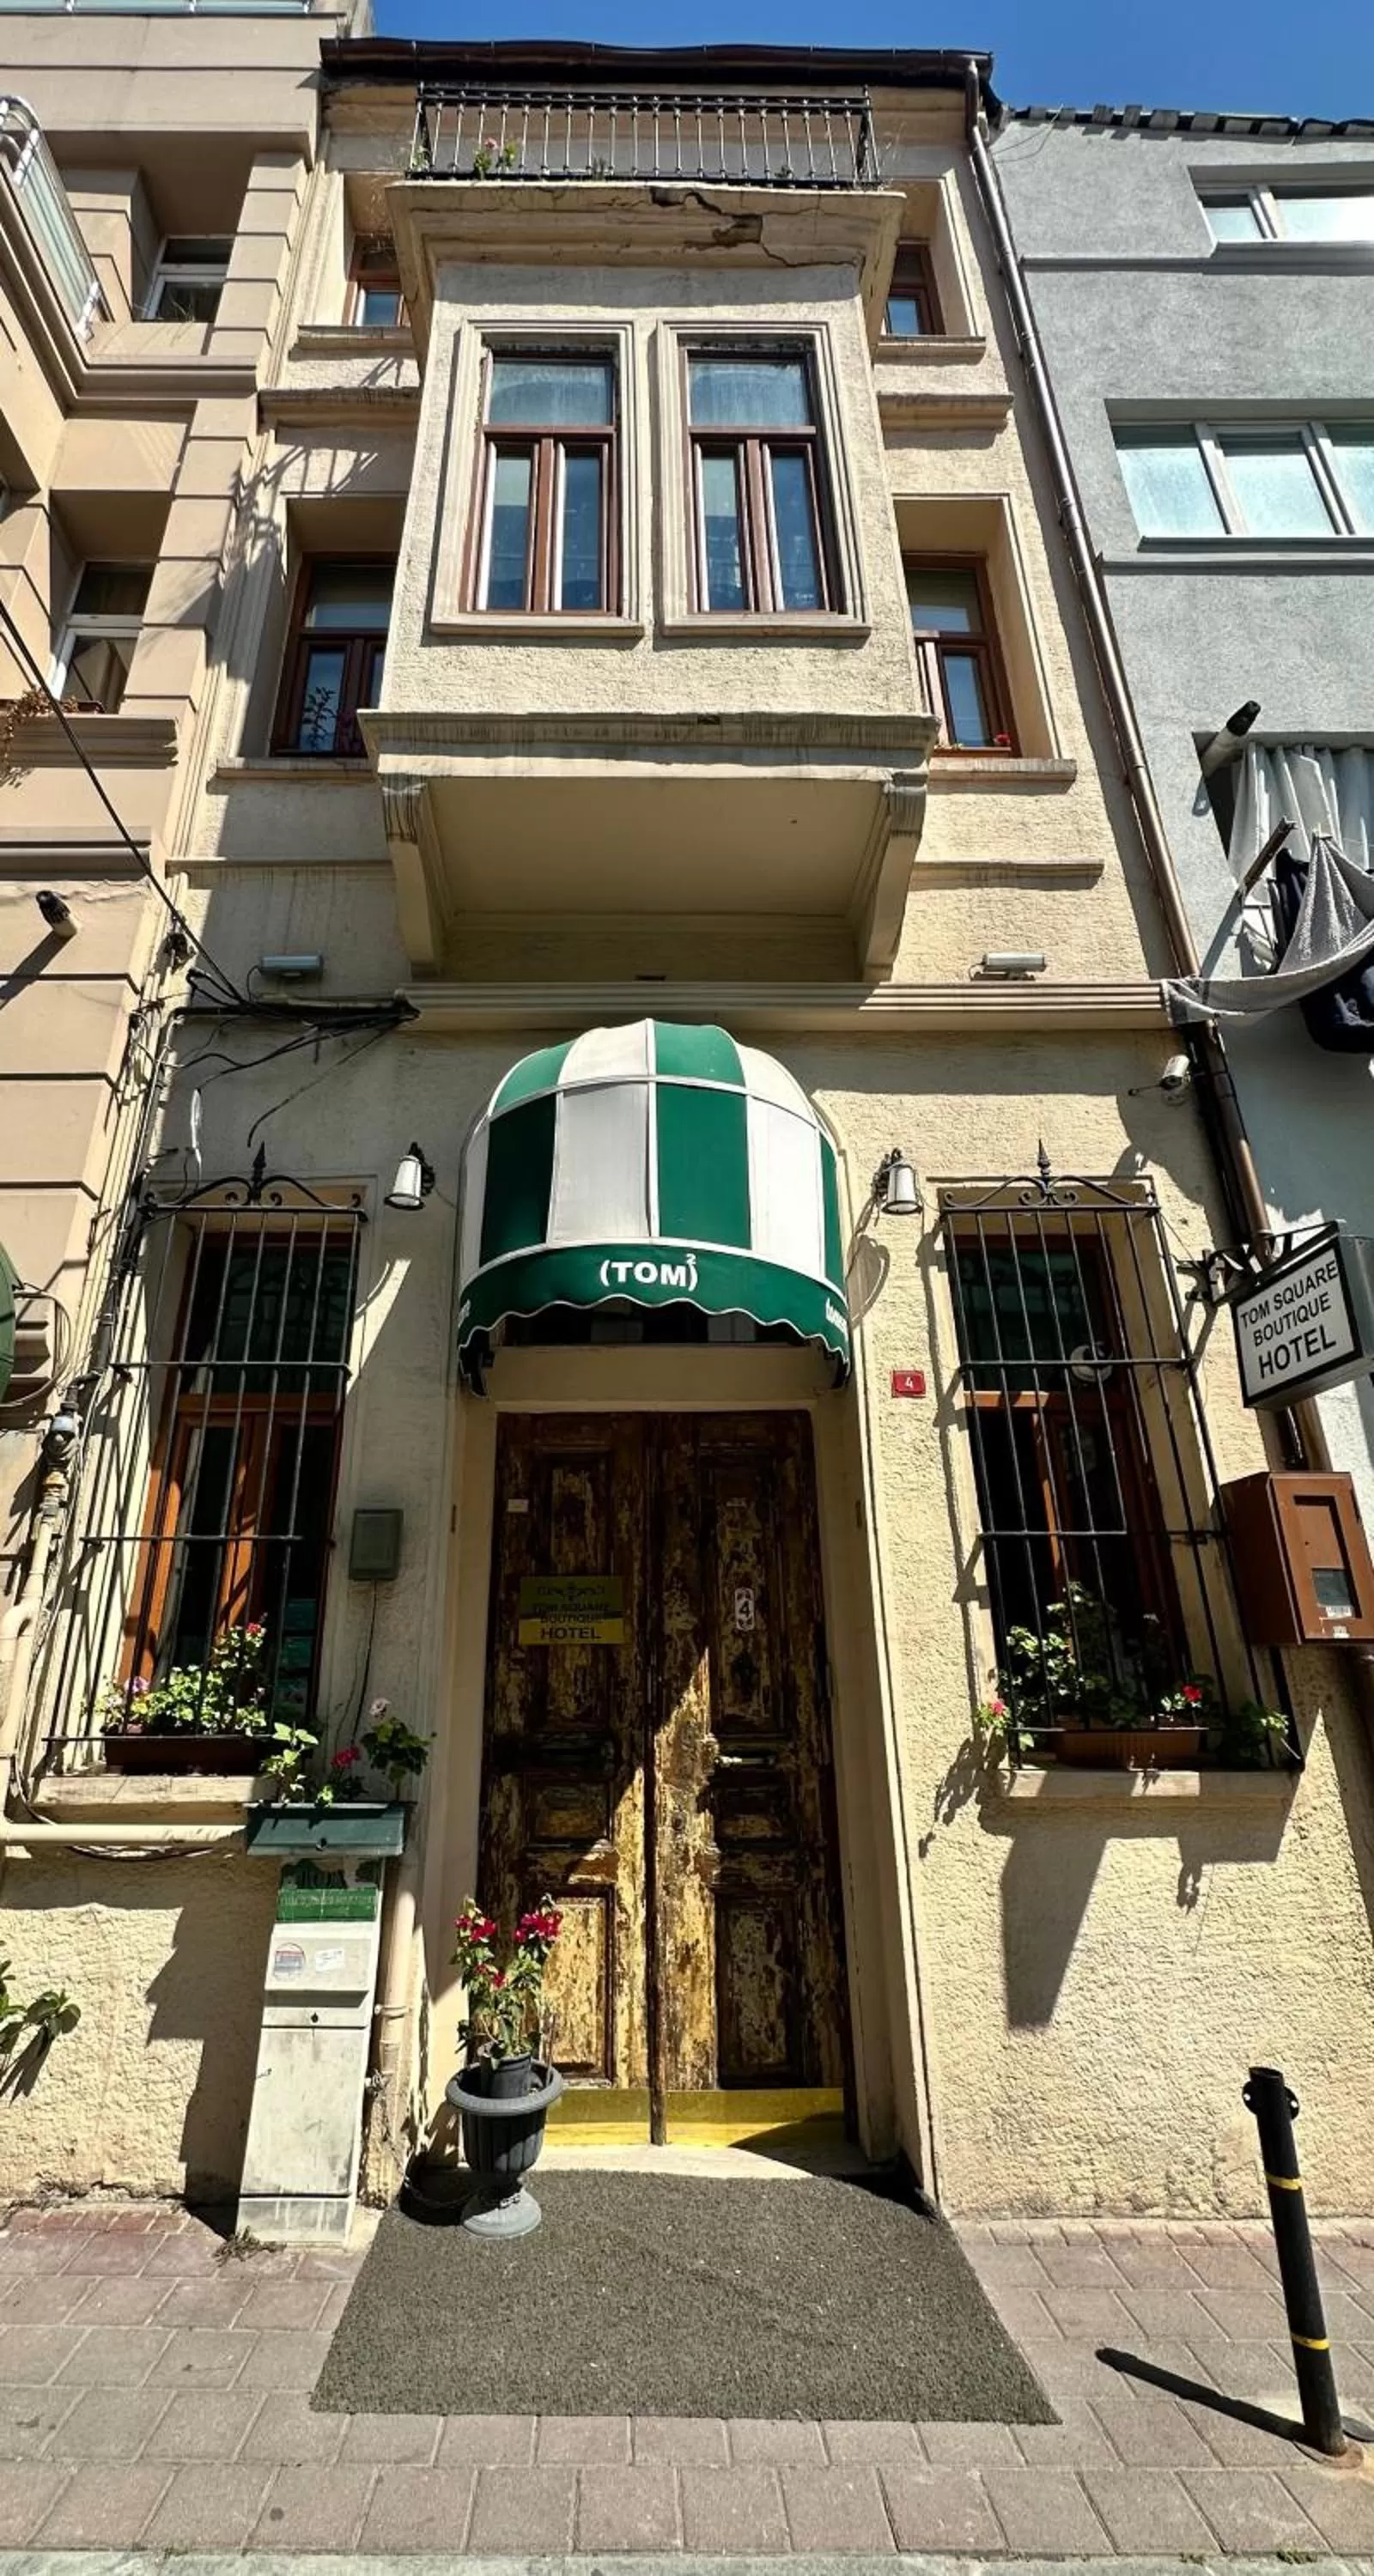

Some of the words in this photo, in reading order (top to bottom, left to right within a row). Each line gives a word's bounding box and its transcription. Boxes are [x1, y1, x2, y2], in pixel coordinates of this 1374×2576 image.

[1240, 1299, 1270, 1329] TOM
[1274, 1260, 1339, 1311] SQUARE
[1253, 1291, 1332, 1347] BOUTIQUE
[1258, 1324, 1337, 1379] HOTEL
[904, 1376, 915, 1389] 4
[739, 1600, 751, 1618] 4
[540, 1627, 602, 1639] HOTEL
